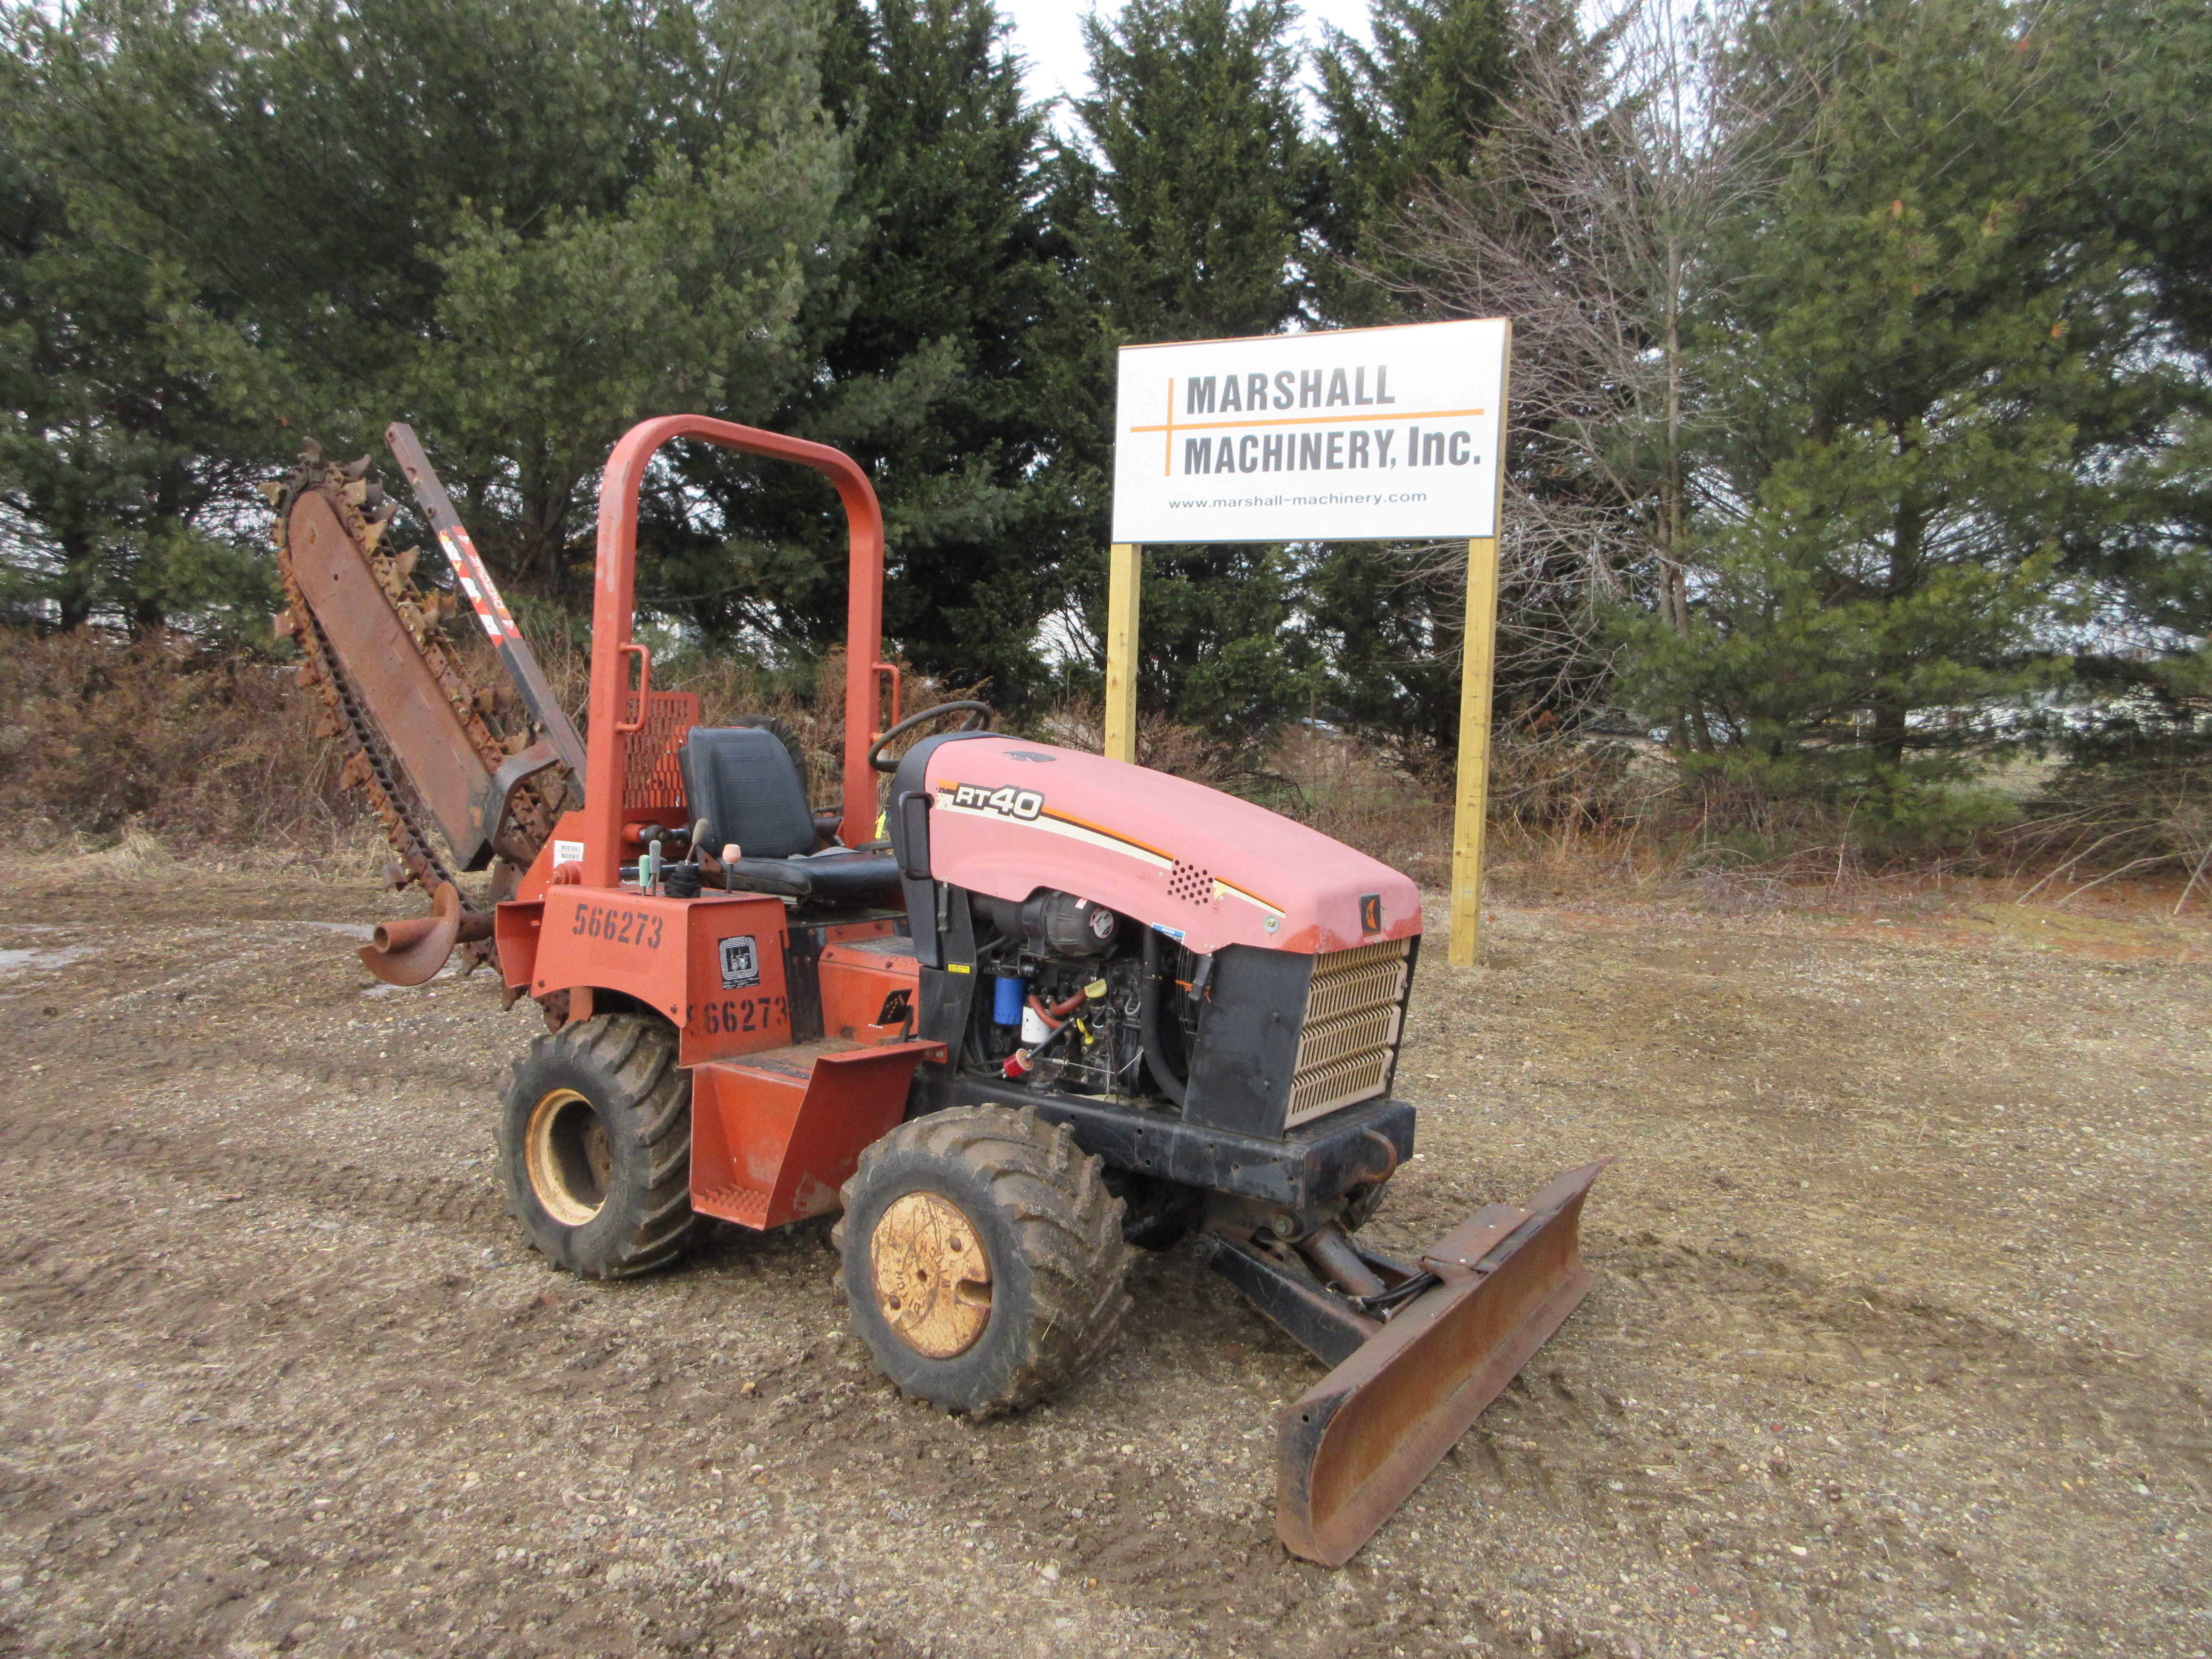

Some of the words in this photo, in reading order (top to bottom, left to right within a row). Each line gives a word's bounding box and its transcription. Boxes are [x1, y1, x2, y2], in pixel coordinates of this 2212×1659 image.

[1187, 364, 1395, 414] MARSHALL
[1184, 429, 1397, 475] MACHINERY,
[1408, 427, 1481, 467] Inc.
[1168, 492, 1427, 509] www.marshall-machinery.com
[956, 788, 1042, 818] RT40
[572, 903, 663, 949] 566273
